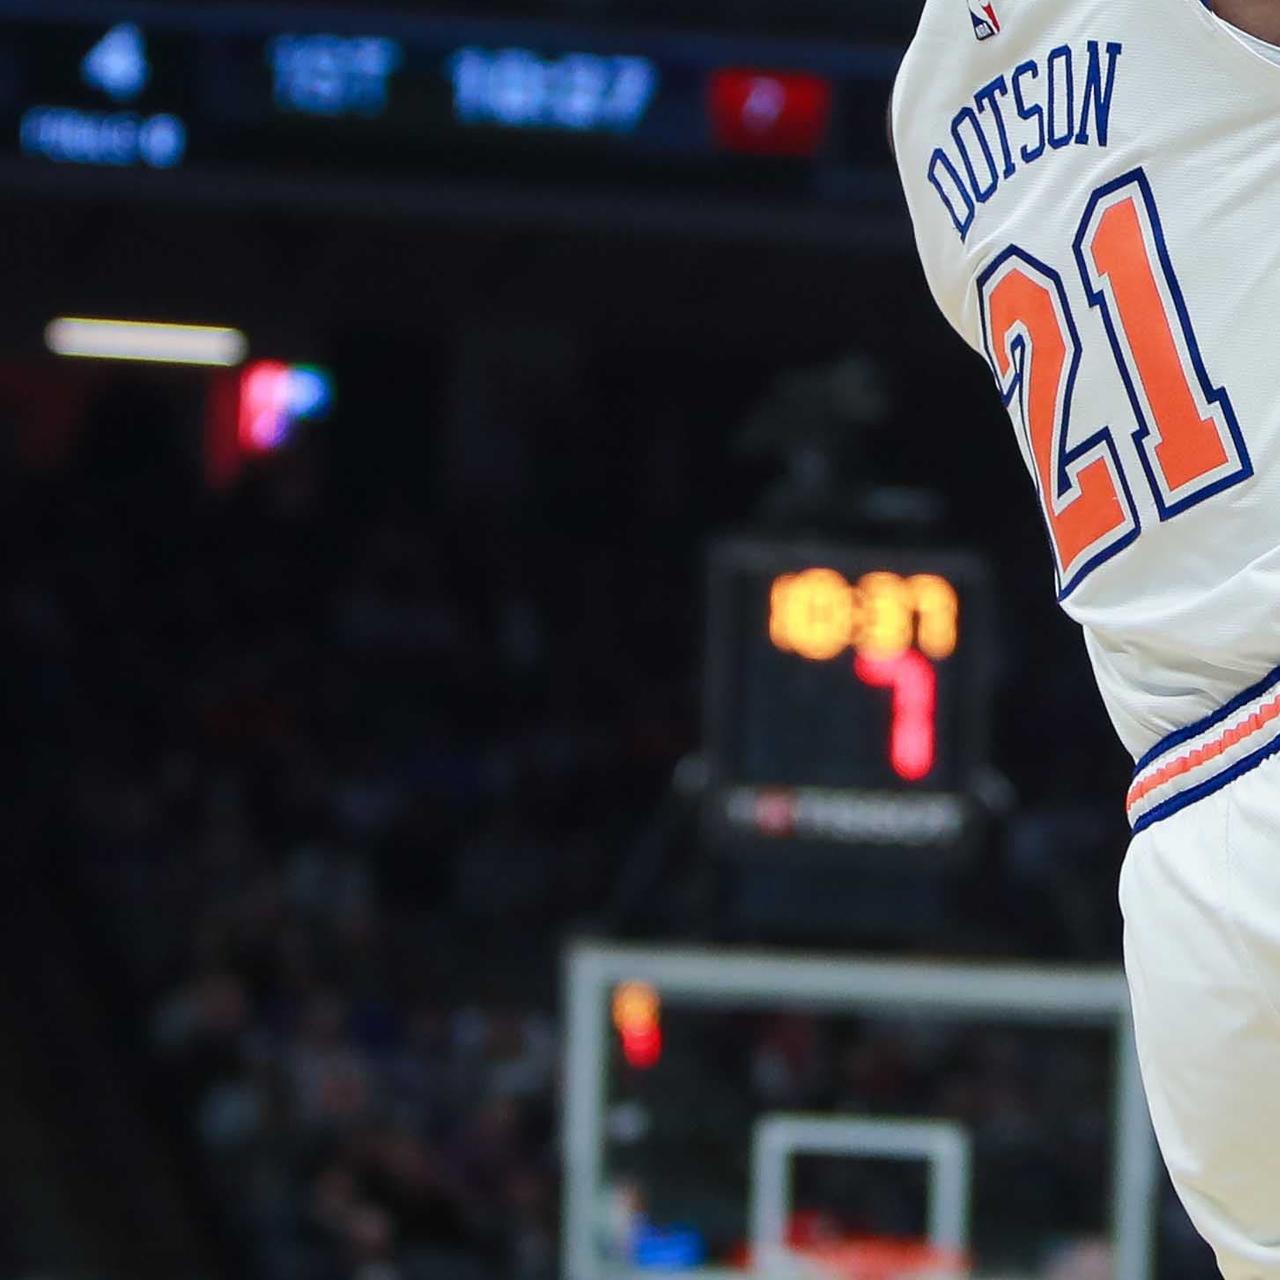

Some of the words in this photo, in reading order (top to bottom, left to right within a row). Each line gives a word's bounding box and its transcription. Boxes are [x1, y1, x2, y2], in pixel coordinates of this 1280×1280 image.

[926, 40, 1122, 242] DOTSON
[974, 166, 1255, 604] 21
[854, 648, 937, 781] 7
